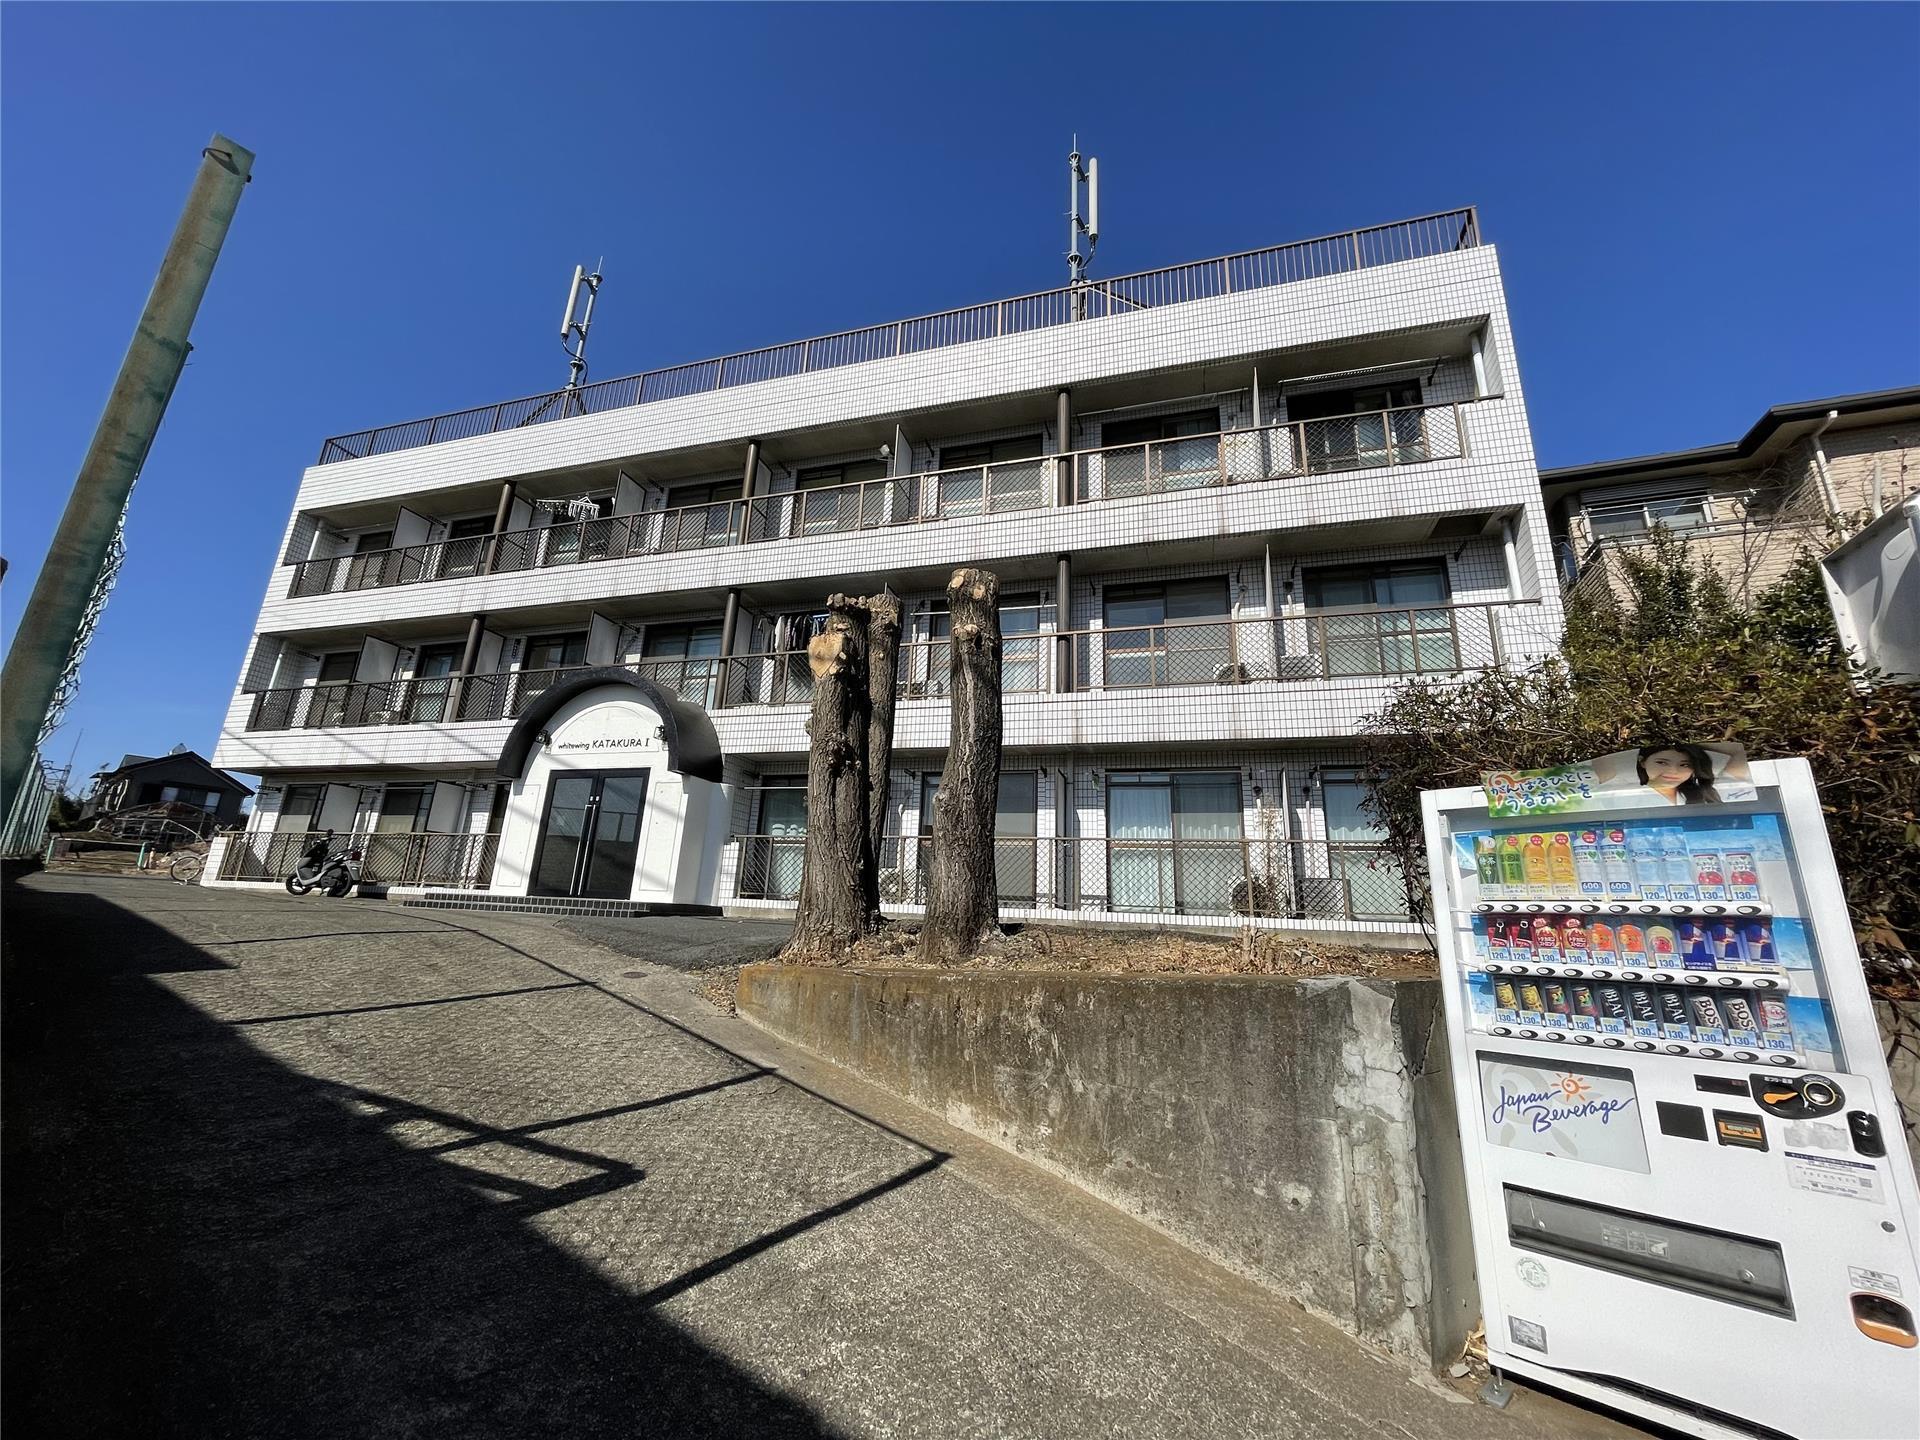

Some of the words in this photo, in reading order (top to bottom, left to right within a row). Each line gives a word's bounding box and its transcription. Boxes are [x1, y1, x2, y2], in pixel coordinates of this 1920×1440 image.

[558, 741, 590, 751] whitewing
[592, 738, 642, 749] KATAKURA
[1490, 771, 1592, 796] がんばるひとに
[1506, 783, 1593, 811] うるおいを
[1632, 991, 1657, 1022] BLAC
[1663, 993, 1689, 1025] BLAC
[1492, 1085, 1562, 1124] Japan
[1522, 1097, 1635, 1134] Beverage
